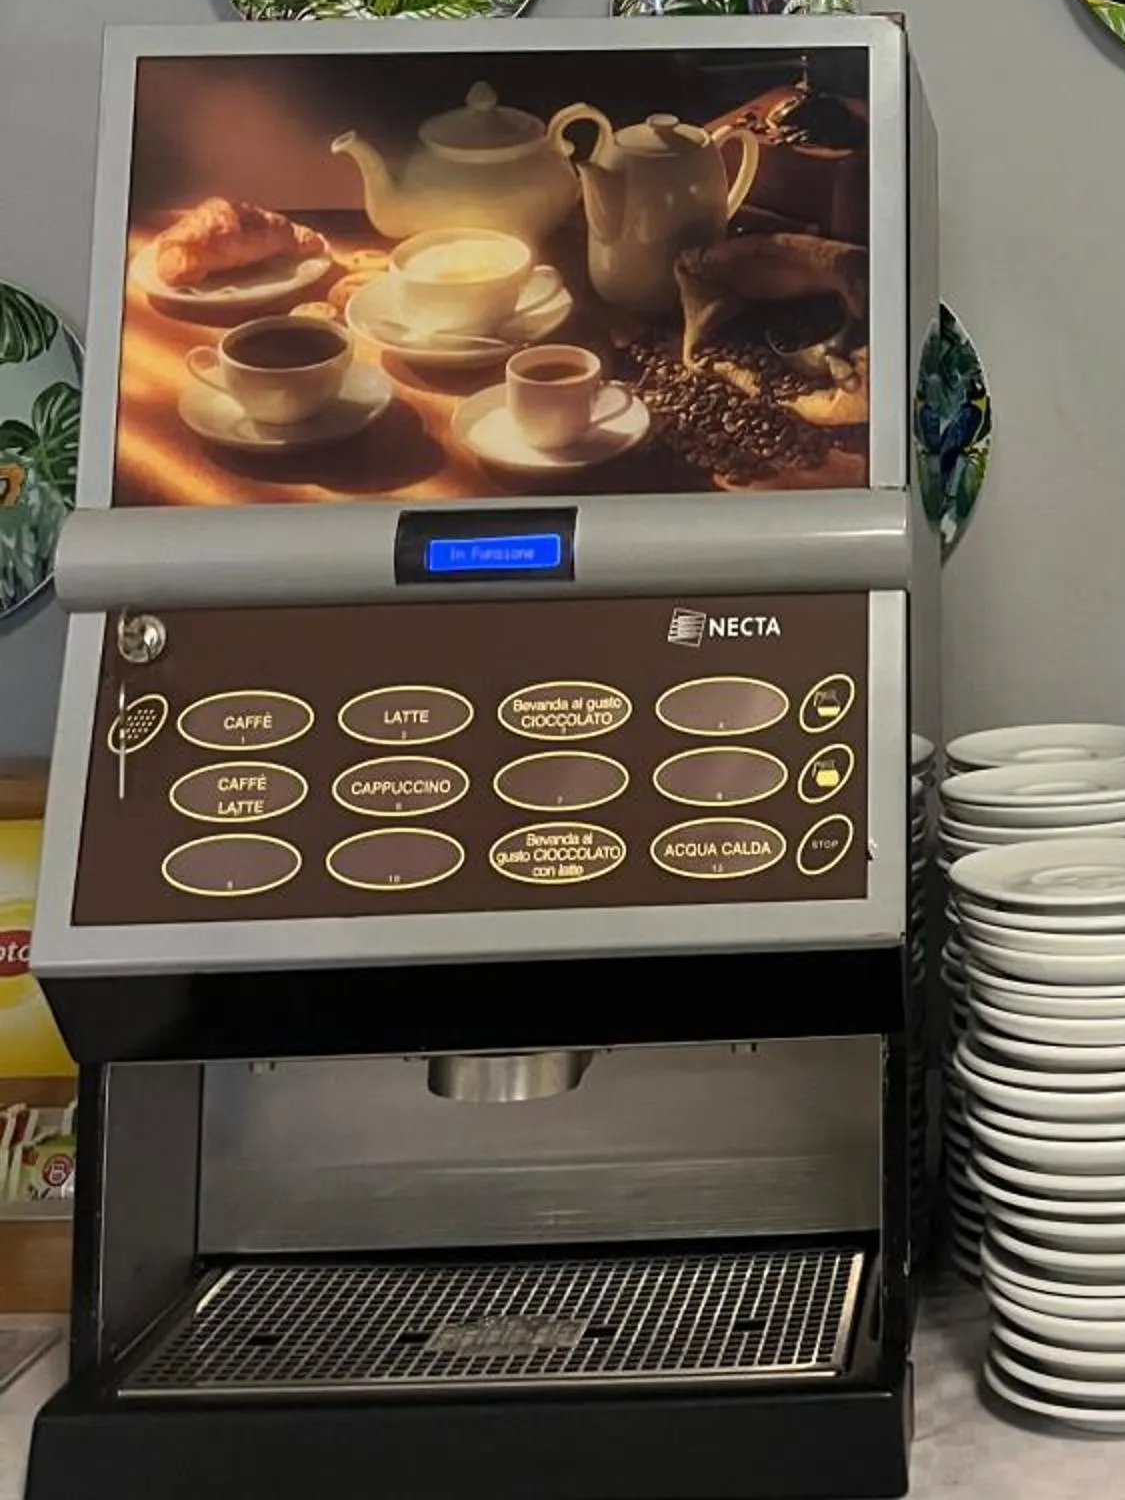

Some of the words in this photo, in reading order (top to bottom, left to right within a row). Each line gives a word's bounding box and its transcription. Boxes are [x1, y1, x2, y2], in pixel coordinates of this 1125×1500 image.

[708, 617, 781, 637] NECTA
[383, 709, 430, 724] LATTE
[521, 712, 613, 728] CIOCCOLATO
[351, 779, 452, 795] CAPPUCCINO
[217, 800, 265, 816] LATTE
[533, 845, 621, 861] CIOCCOLATO
[664, 843, 718, 858] ACQUA
[721, 841, 771, 856] CALDA
